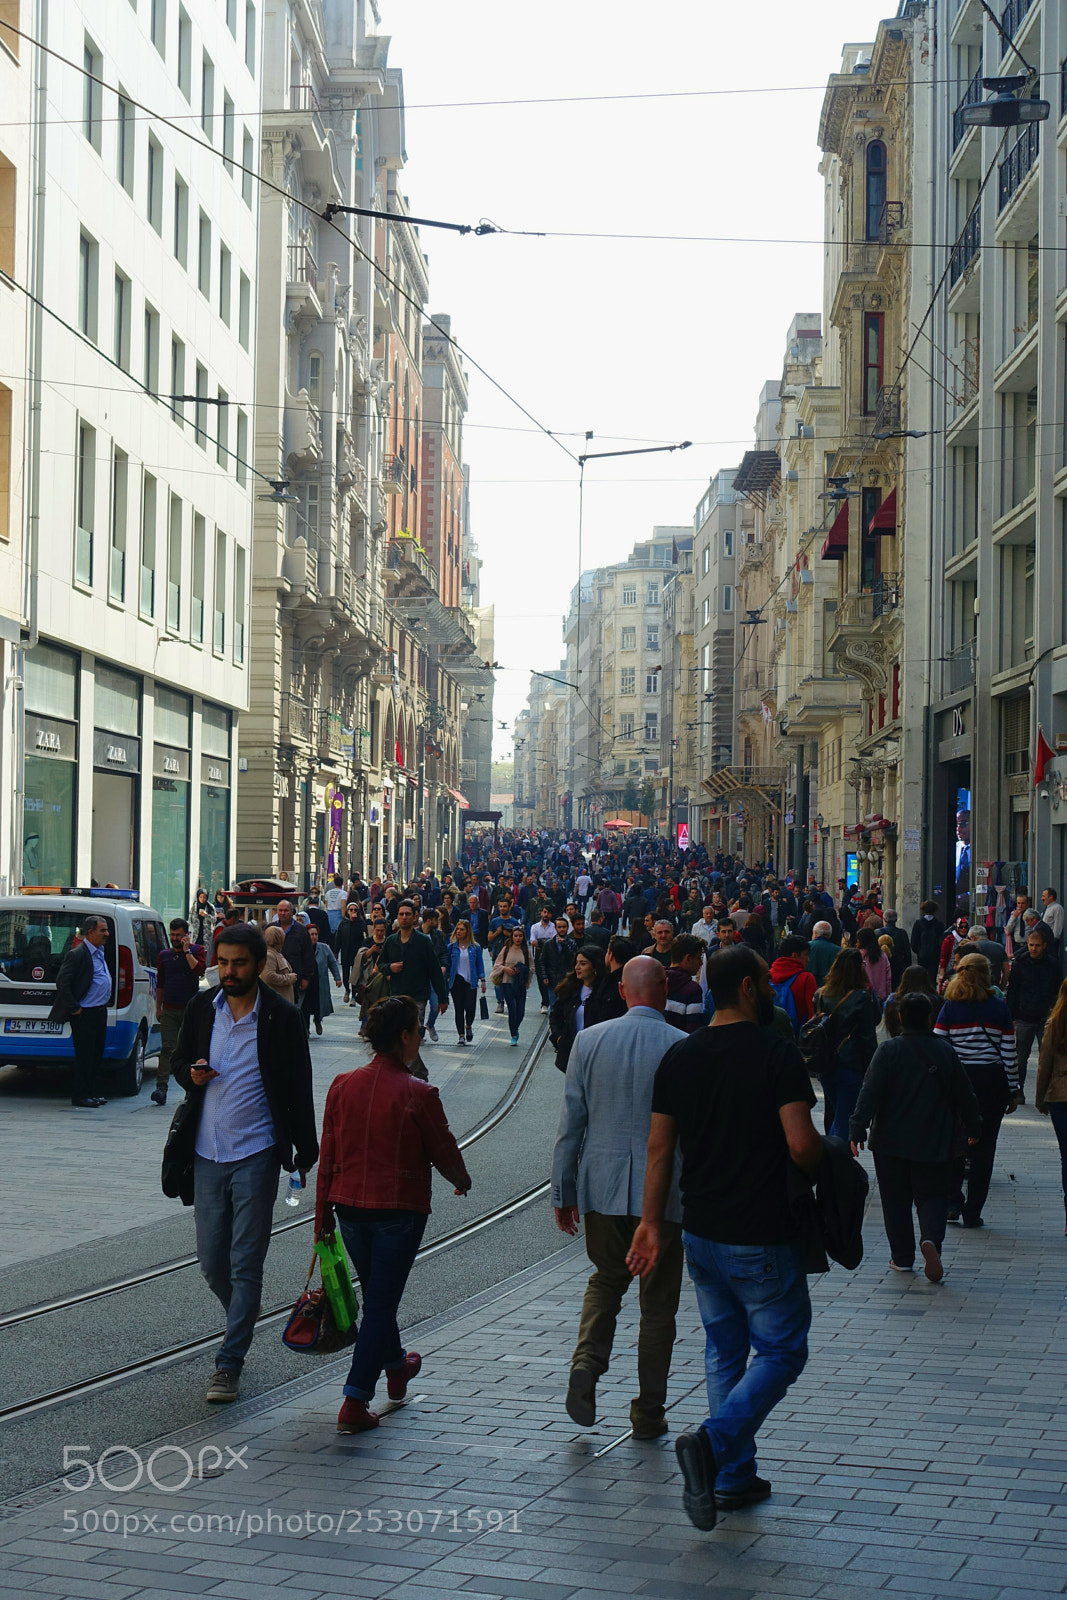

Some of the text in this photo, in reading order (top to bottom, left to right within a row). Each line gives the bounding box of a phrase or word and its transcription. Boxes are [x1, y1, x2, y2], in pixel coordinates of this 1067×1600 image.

[38, 730, 61, 750] ZARA
[107, 745, 127, 763] ZARA
[164, 757, 180, 772] ZARA
[209, 766, 222, 780] ZARA
[11, 1021, 21, 1030] 34
[25, 1021, 36, 1030] RV
